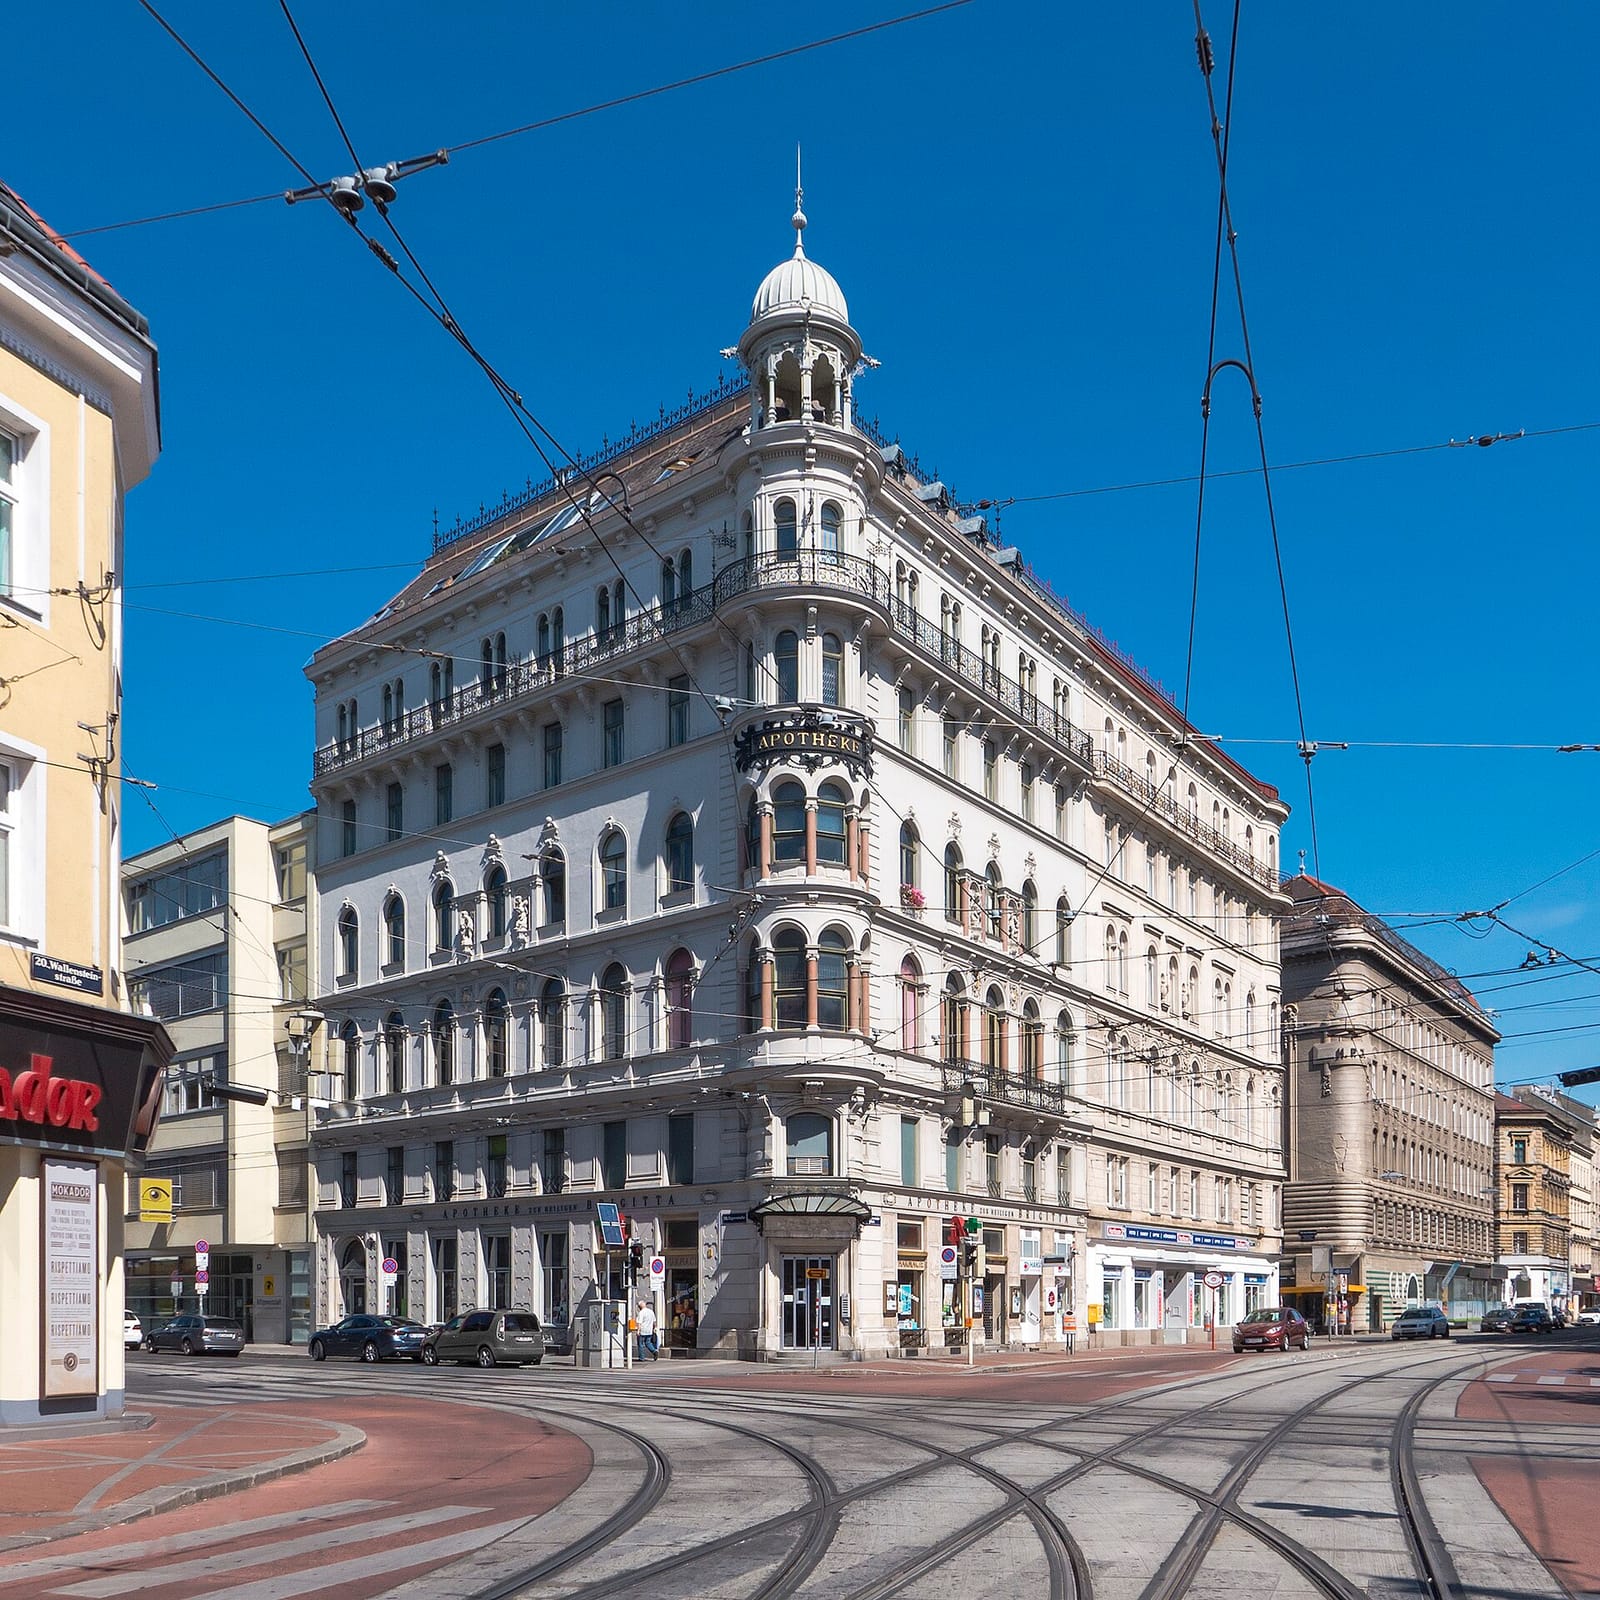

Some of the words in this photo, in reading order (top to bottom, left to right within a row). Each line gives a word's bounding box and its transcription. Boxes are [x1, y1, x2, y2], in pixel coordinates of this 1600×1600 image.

[759, 732, 861, 754] APOTHEKE
[54, 973, 83, 986] straße
[52, 1184, 90, 1198] MOKADOR
[442, 1205, 520, 1219] APOTHEKE
[586, 1194, 674, 1210] BGITTA
[907, 1197, 975, 1214] APOTHEKE
[1018, 1209, 1069, 1224] BRIGITTA
[51, 1261, 91, 1274] RISPETTIAMO
[51, 1292, 91, 1305] RISPETTIAMO
[51, 1324, 91, 1336] RISPETTIAMO
